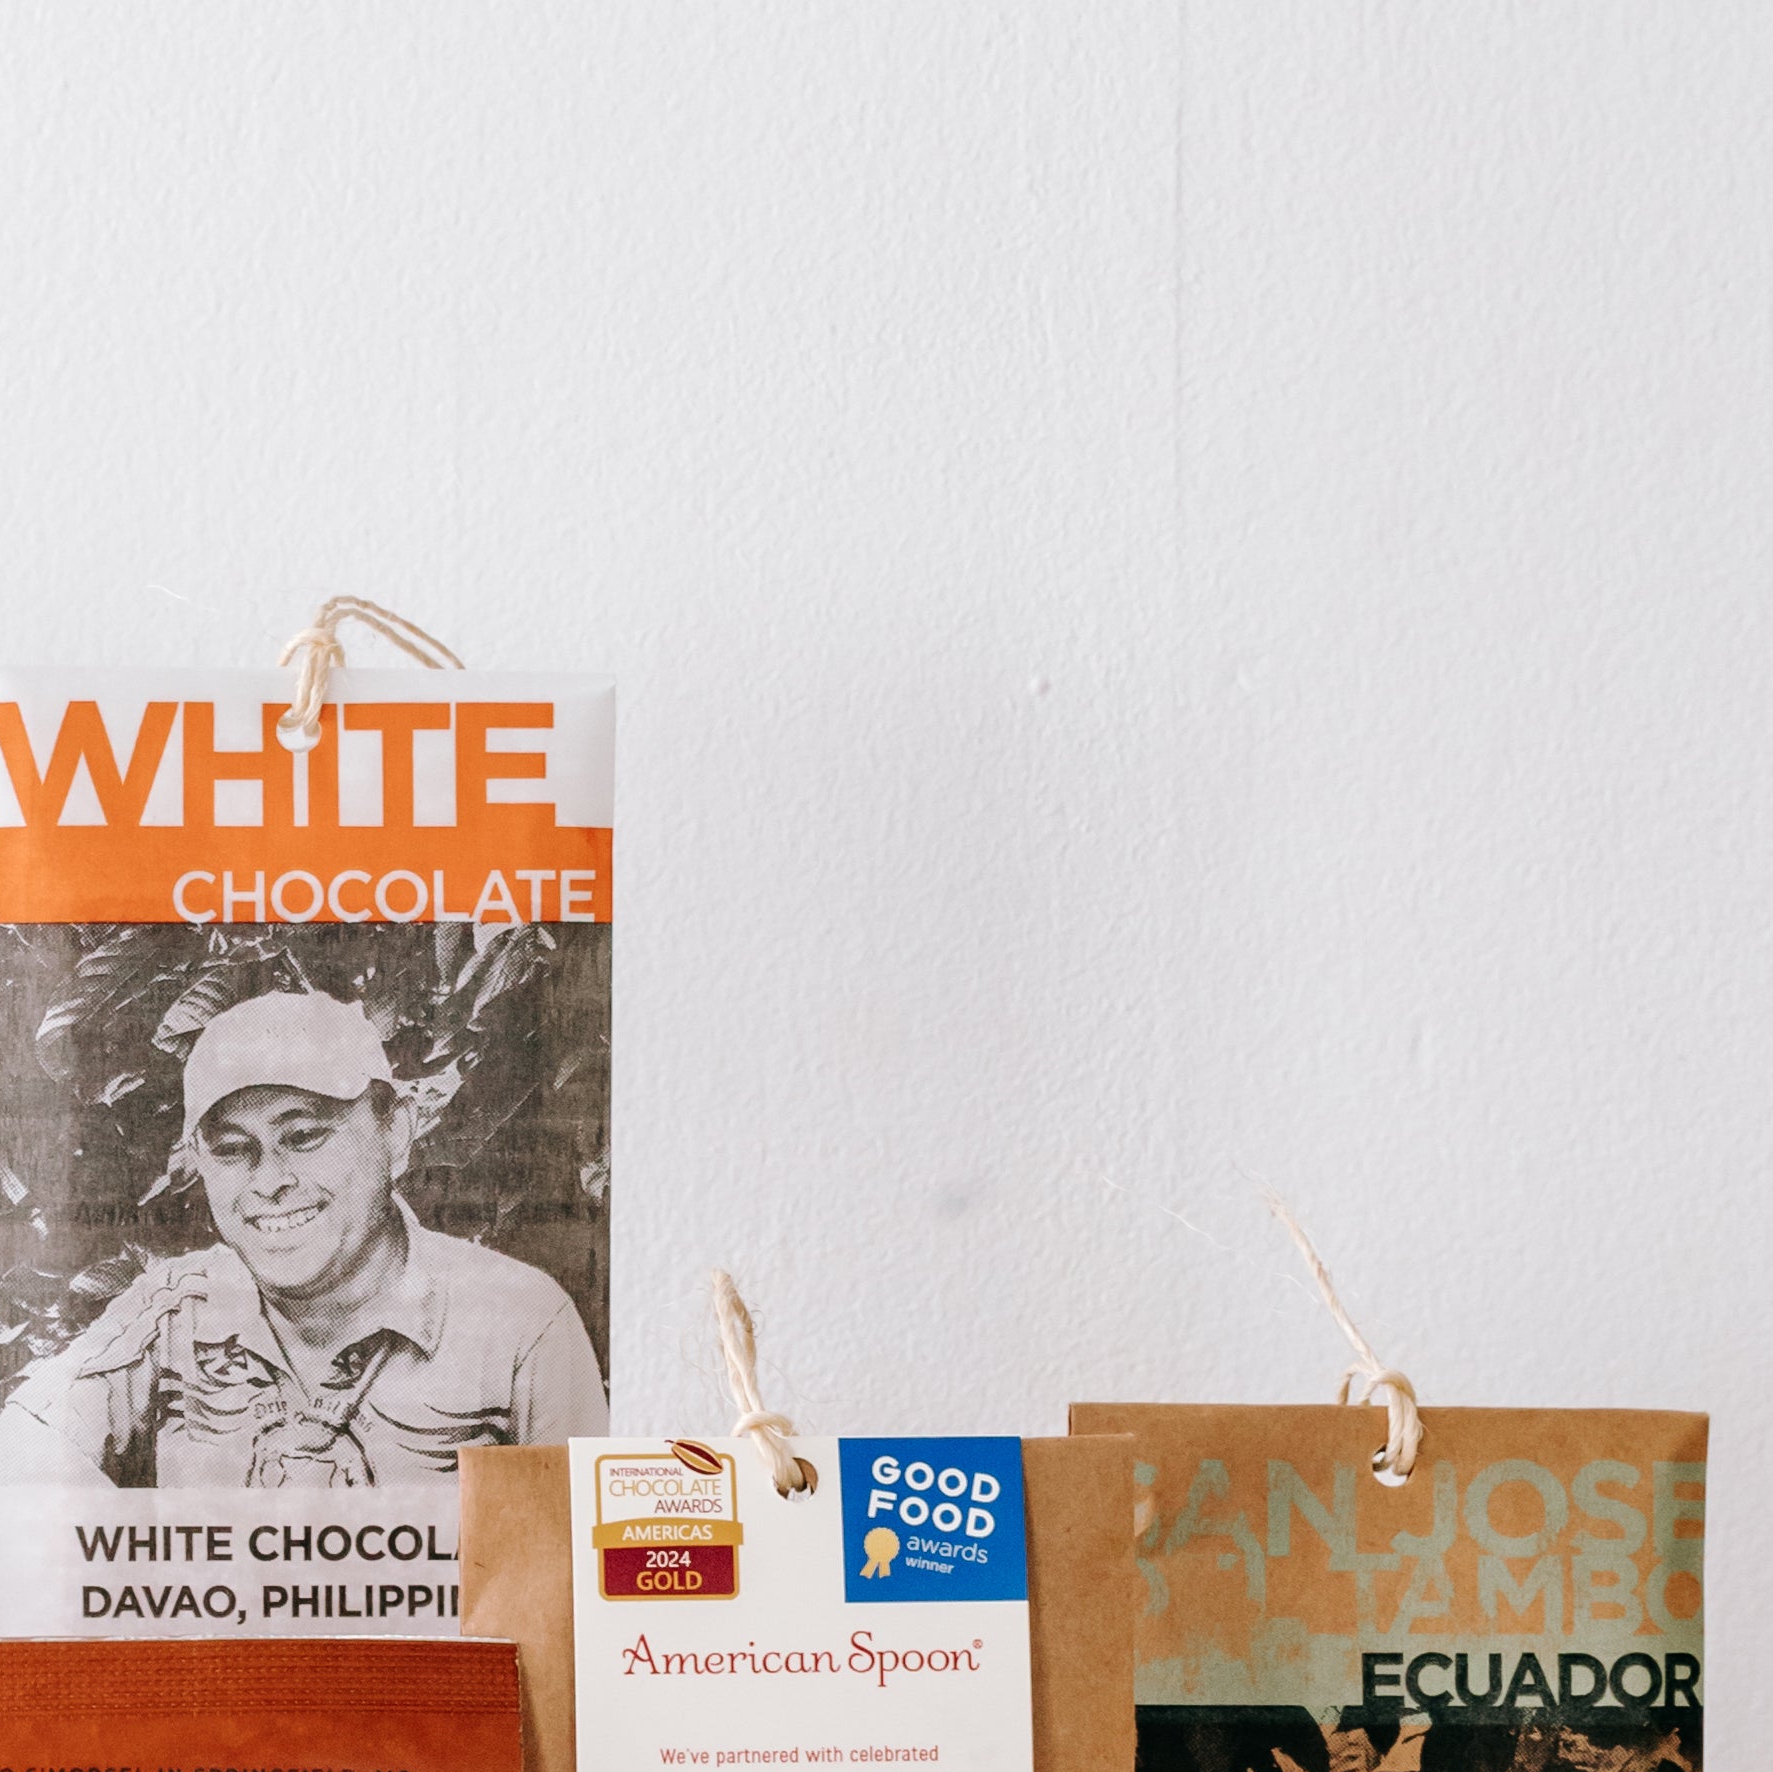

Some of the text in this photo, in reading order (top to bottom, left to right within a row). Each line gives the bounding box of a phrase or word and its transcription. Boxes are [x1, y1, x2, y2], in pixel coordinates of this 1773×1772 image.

[172, 869, 597, 922] CHOCOLATE
[610, 1467, 684, 1477] INTERNATIONAL
[871, 1455, 1001, 1504] GOOD
[609, 1479, 722, 1497] CHOCOLATE
[654, 1499, 723, 1513] AWARDS
[867, 1489, 996, 1539] FOOD
[75, 1525, 459, 1562] WHITE CHOCOL
[622, 1524, 713, 1542] AMERICAS
[645, 1550, 692, 1569] 2024
[906, 1535, 988, 1565] awards
[905, 1555, 955, 1575] winner
[636, 1570, 703, 1591] GOLD
[82, 1585, 246, 1625] DAVAO,
[622, 1633, 841, 1676] American
[1362, 1652, 1702, 1708] ECUADOR
[660, 1746, 939, 1768] We've partnered with celebrated
